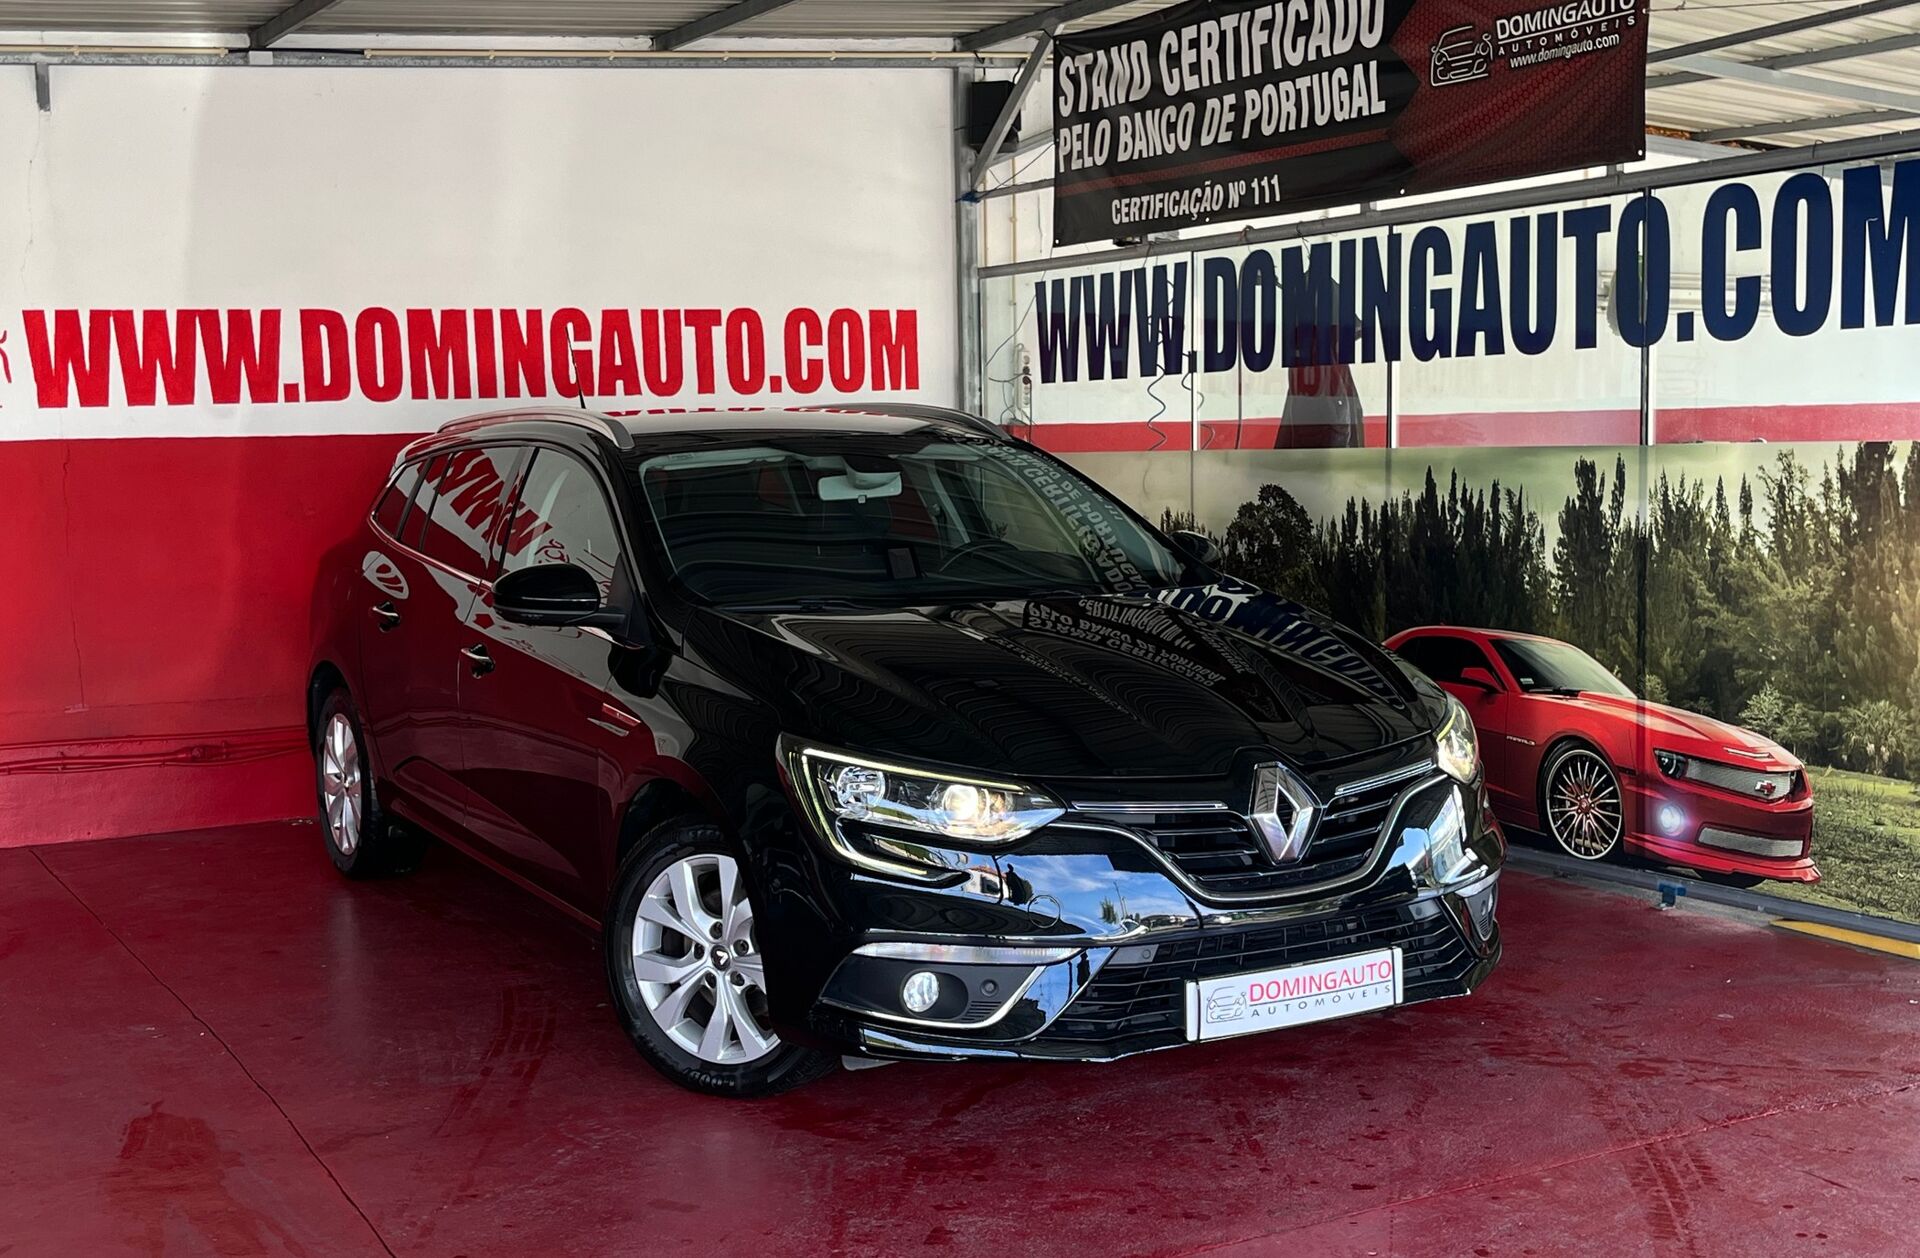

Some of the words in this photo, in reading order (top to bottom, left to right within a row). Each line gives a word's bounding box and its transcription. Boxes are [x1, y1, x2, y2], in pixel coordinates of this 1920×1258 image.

[1496, 0, 1635, 39] DOMINGAUTO
[1498, 16, 1635, 56] AUTOMÓVEIS
[1059, 40, 1151, 117] STAND
[1159, 0, 1385, 96] CERTIFICADO
[1510, 33, 1620, 68] www.domingauto.com
[1058, 118, 1111, 173] PELO
[1117, 99, 1196, 162] BANCO
[1200, 93, 1236, 147] DE
[1242, 60, 1386, 139] PORTUGAL
[1111, 179, 1223, 224] CERTIFICAÇÃO
[1249, 174, 1281, 205] 111
[1034, 159, 1920, 384] WWW.DOMINGAUTO.COM
[22, 307, 919, 406] WWW.DOMINGAUTO.COM
[1249, 960, 1392, 1002] DOMINGAUTO
[1251, 985, 1390, 1018] AUTOMÓVEIS
